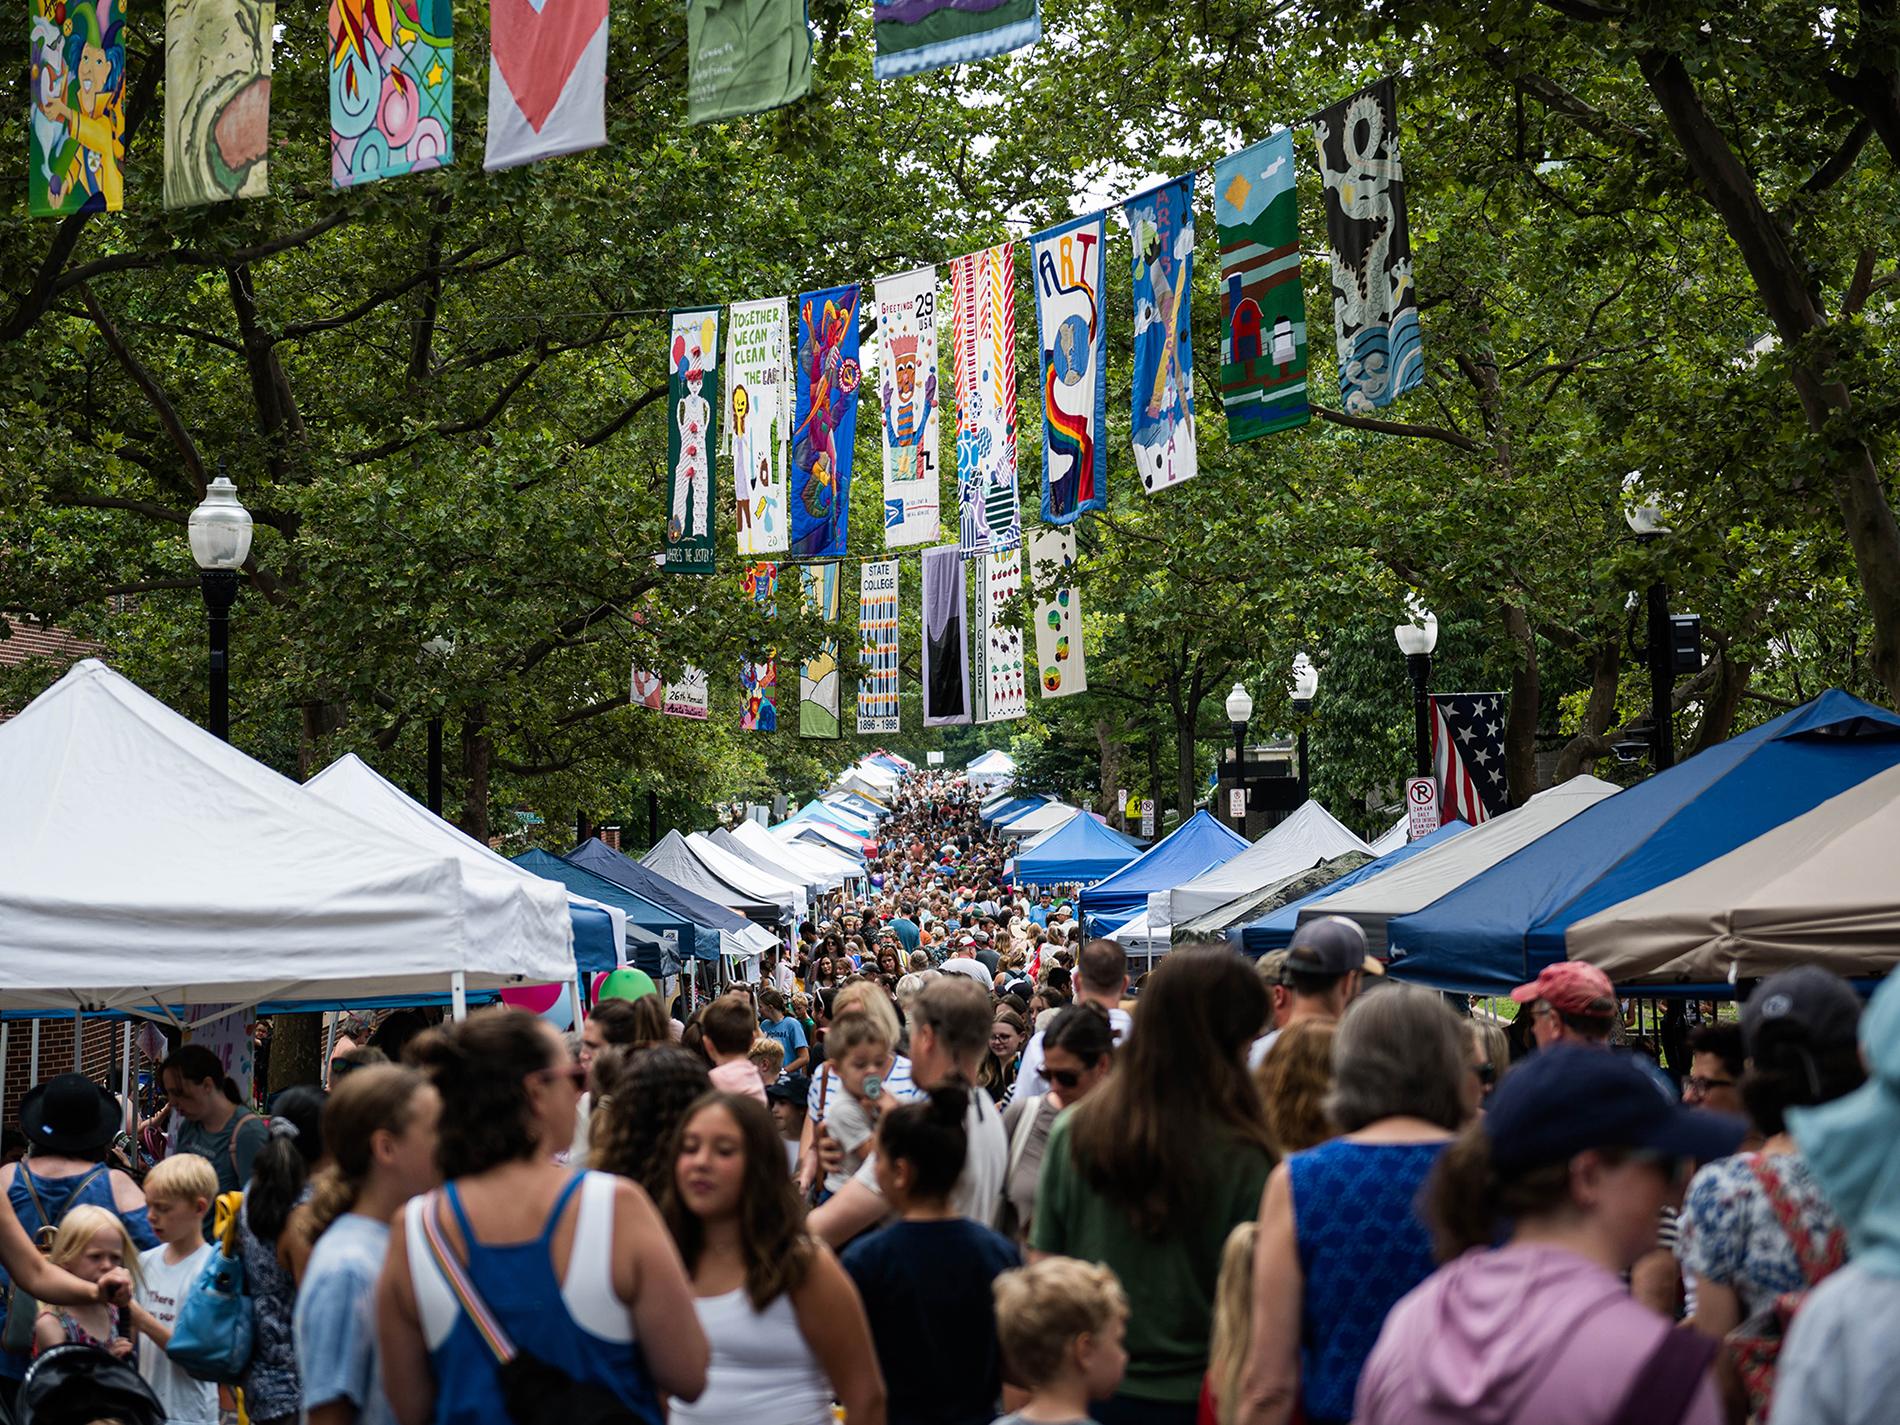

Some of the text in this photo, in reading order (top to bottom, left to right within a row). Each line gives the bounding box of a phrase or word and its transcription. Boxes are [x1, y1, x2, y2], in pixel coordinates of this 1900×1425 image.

[1156, 189, 1171, 276] ARTS
[1039, 233, 1097, 298] ART
[915, 291, 934, 318] 29
[733, 308, 779, 329] TOGETHER
[919, 316, 933, 331] USA
[734, 328, 768, 347] WE CAN
[735, 346, 766, 365] CLEAN
[744, 369, 761, 386] THE
[869, 564, 890, 577] STATE
[863, 578, 894, 591] COLLEGE
[859, 719, 876, 730] 1896
[882, 718, 898, 730] 1996
